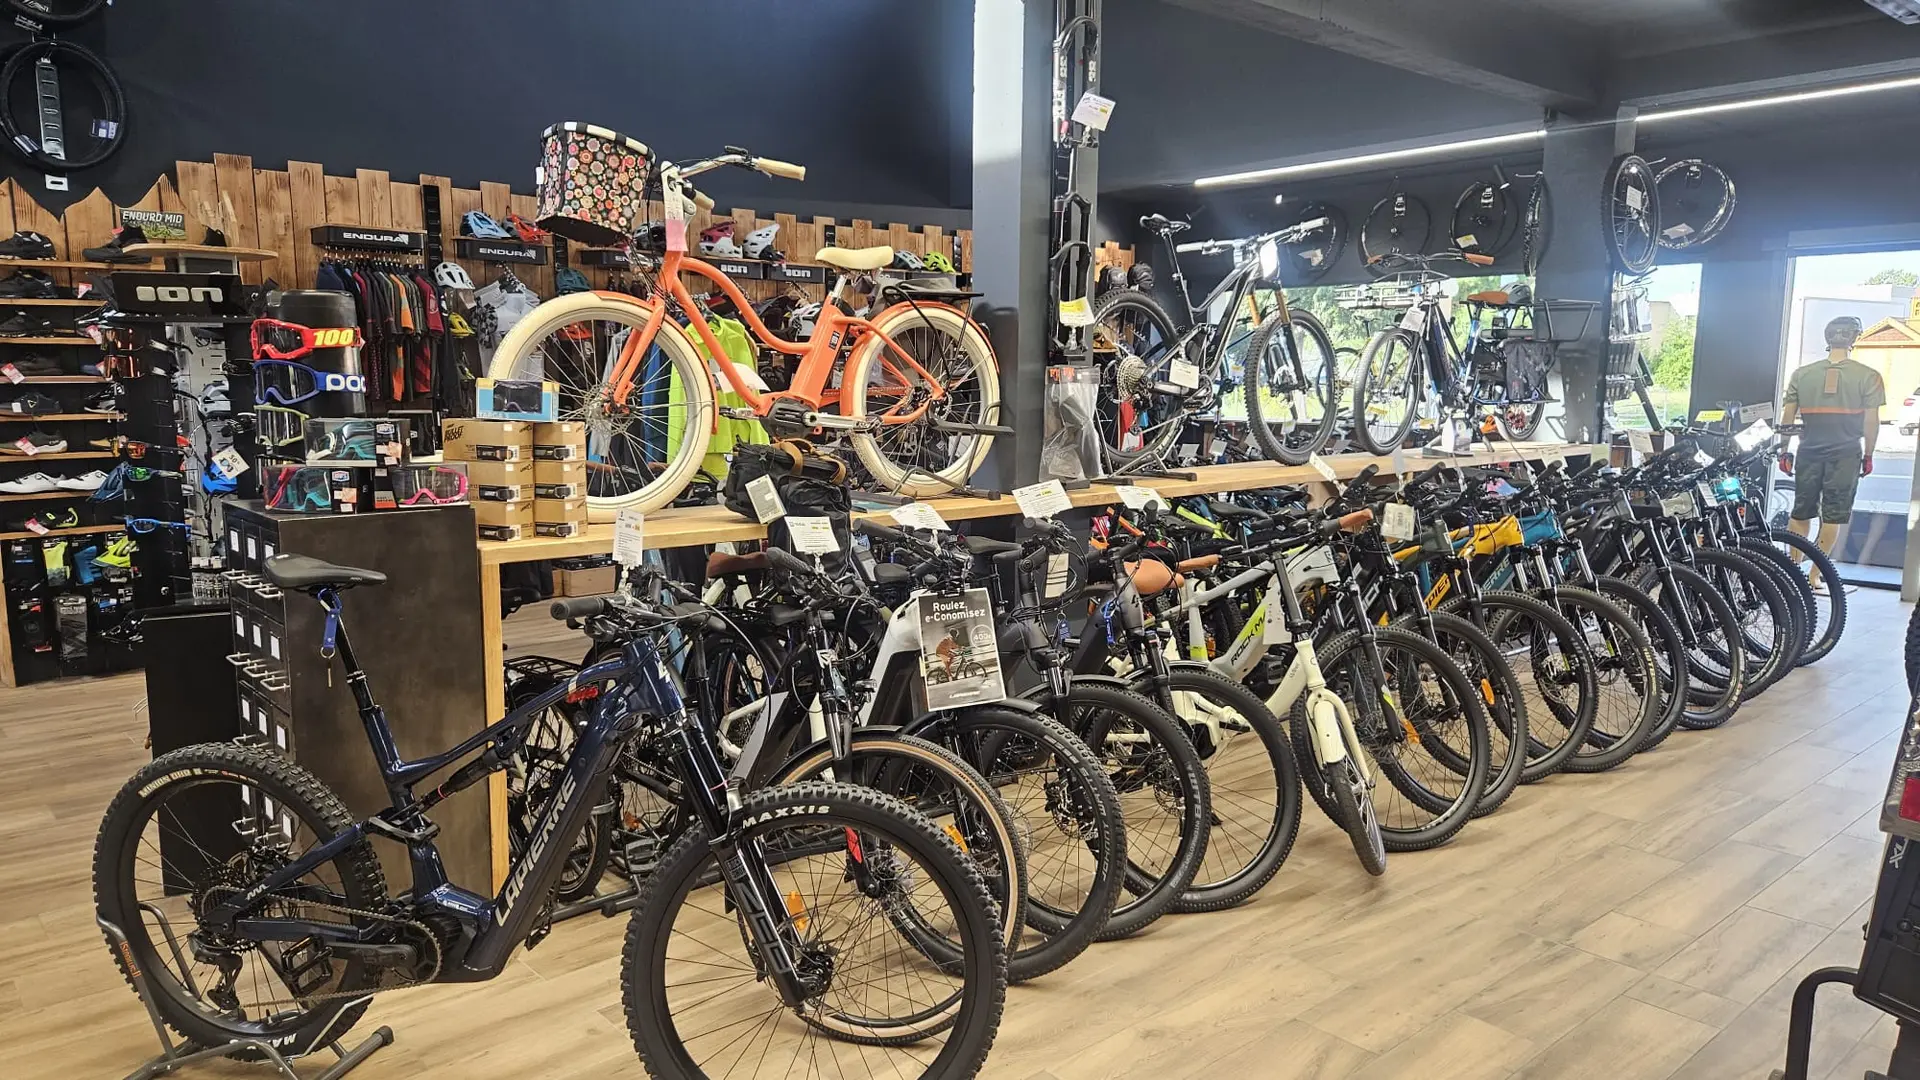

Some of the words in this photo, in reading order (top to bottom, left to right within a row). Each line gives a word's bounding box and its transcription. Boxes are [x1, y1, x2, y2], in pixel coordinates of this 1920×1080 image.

[164, 214, 183, 224] MID
[342, 231, 403, 243] ENDURA
[479, 247, 531, 258] ENDURA
[720, 264, 748, 274] ION
[136, 286, 223, 303] ION
[924, 606, 986, 623] e-Conomisez
[742, 804, 831, 829] MAXXIS
[494, 767, 577, 928] LAPIERRE
